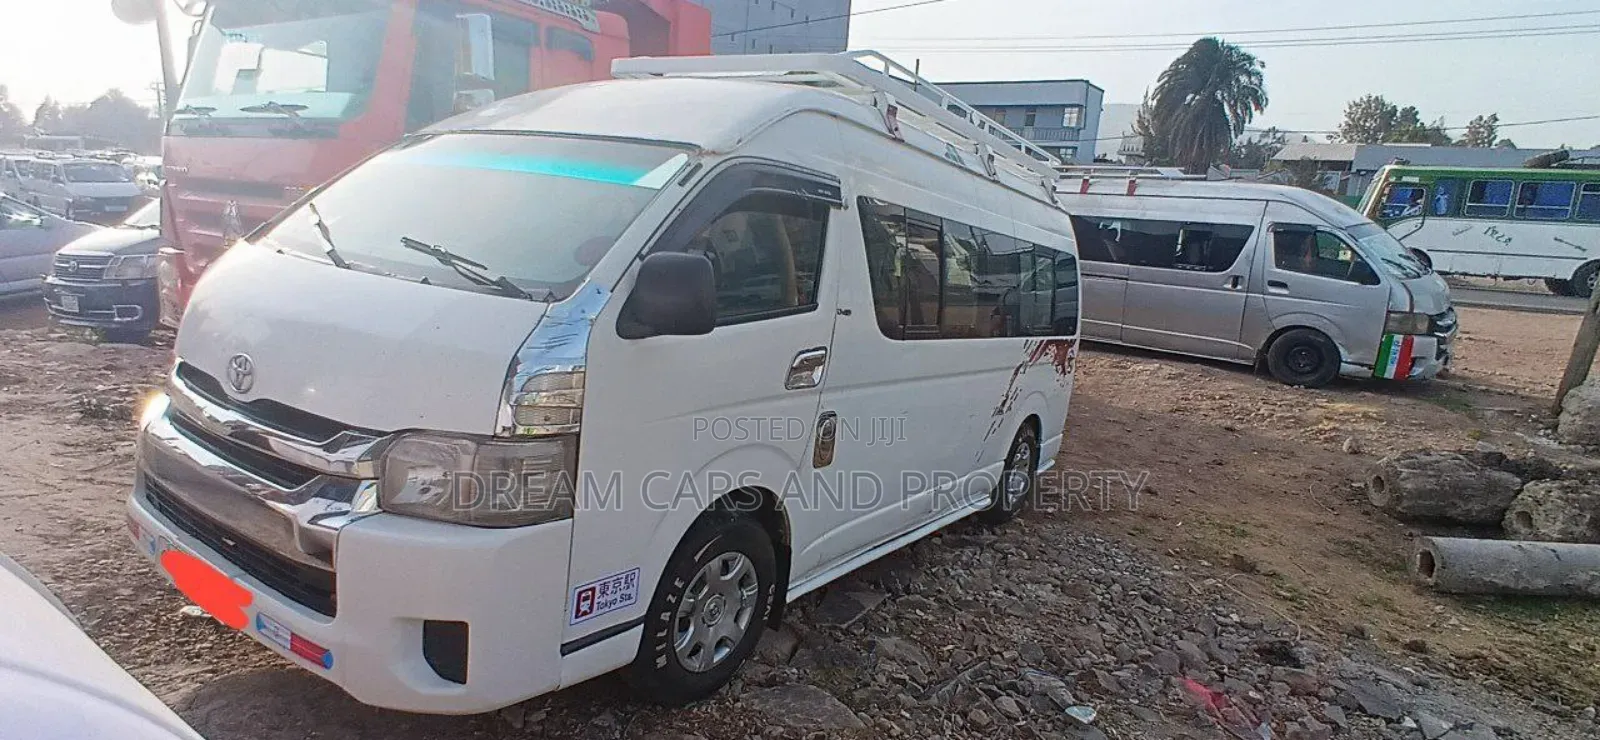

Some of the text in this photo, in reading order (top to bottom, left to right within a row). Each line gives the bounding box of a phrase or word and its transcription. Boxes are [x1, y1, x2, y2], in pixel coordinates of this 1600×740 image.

[597, 572, 636, 599] 東京駅
[596, 598, 617, 611] Tokyo
[655, 577, 685, 669] MILAZE
